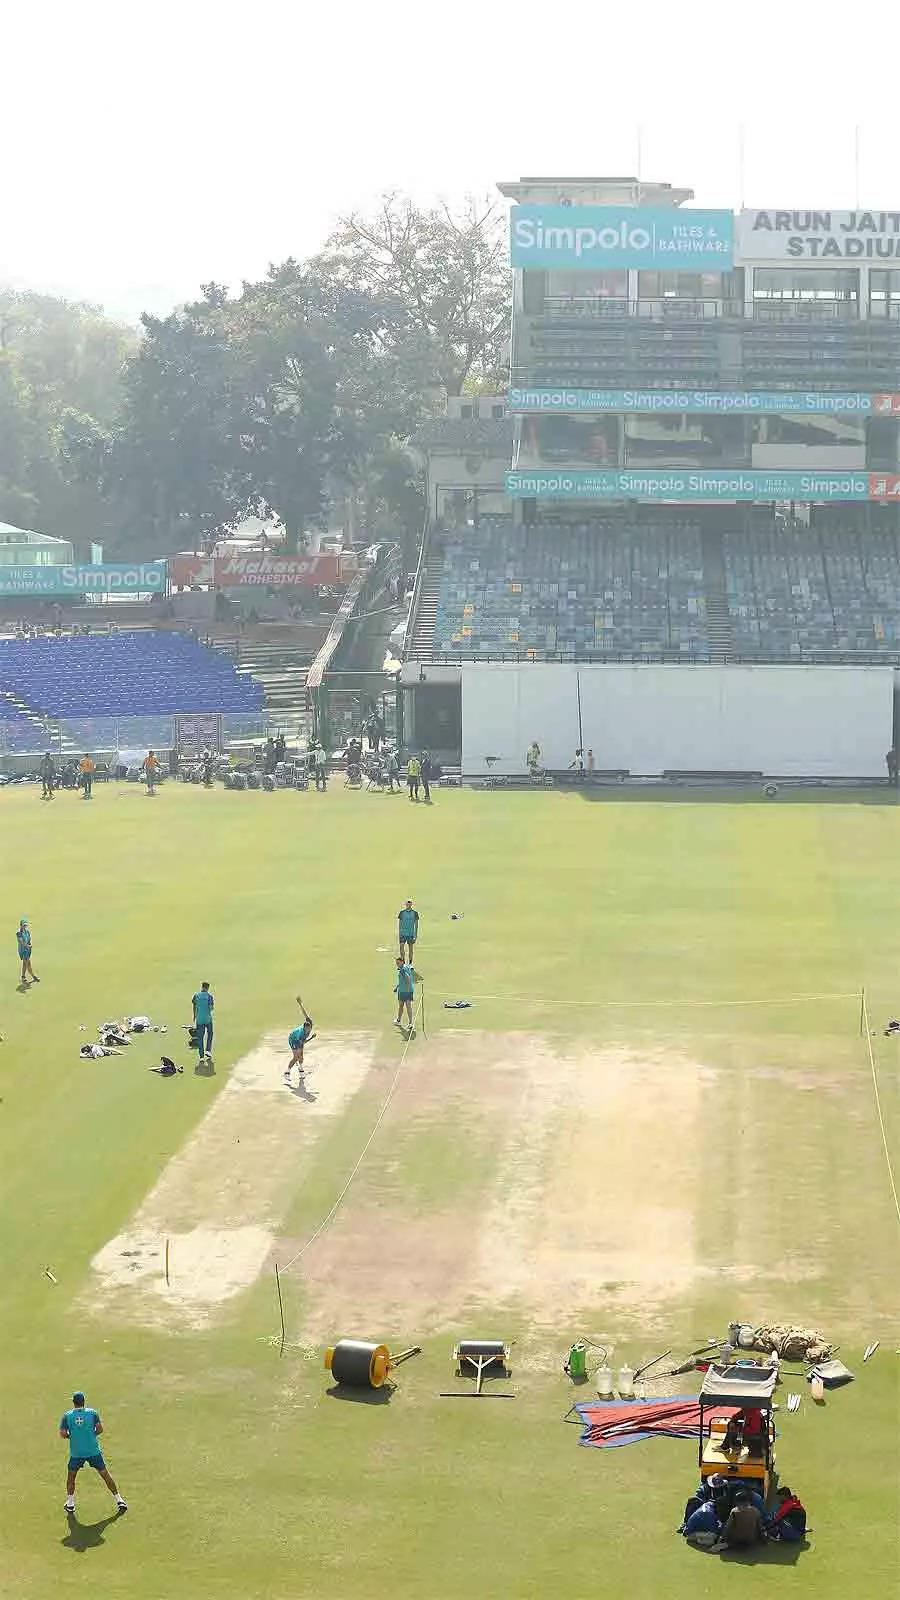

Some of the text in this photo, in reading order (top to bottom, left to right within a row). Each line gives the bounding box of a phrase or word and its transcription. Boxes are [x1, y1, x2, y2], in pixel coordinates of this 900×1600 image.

[752, 211, 832, 232] ARUN
[514, 219, 650, 257] Simpolo
[785, 236, 900, 257] STADIU
[511, 388, 577, 406] Simpolo
[623, 391, 689, 409] Simpolo
[693, 392, 760, 410] Simpolo
[805, 393, 872, 411] Simpolo
[506, 475, 573, 493] Simpolo
[618, 476, 684, 494] Simpolo
[688, 476, 754, 494] Simpolo
[801, 477, 865, 495] Simpolo
[62, 566, 161, 592] Simpolo
[239, 574, 303, 585] ADHESIVE
